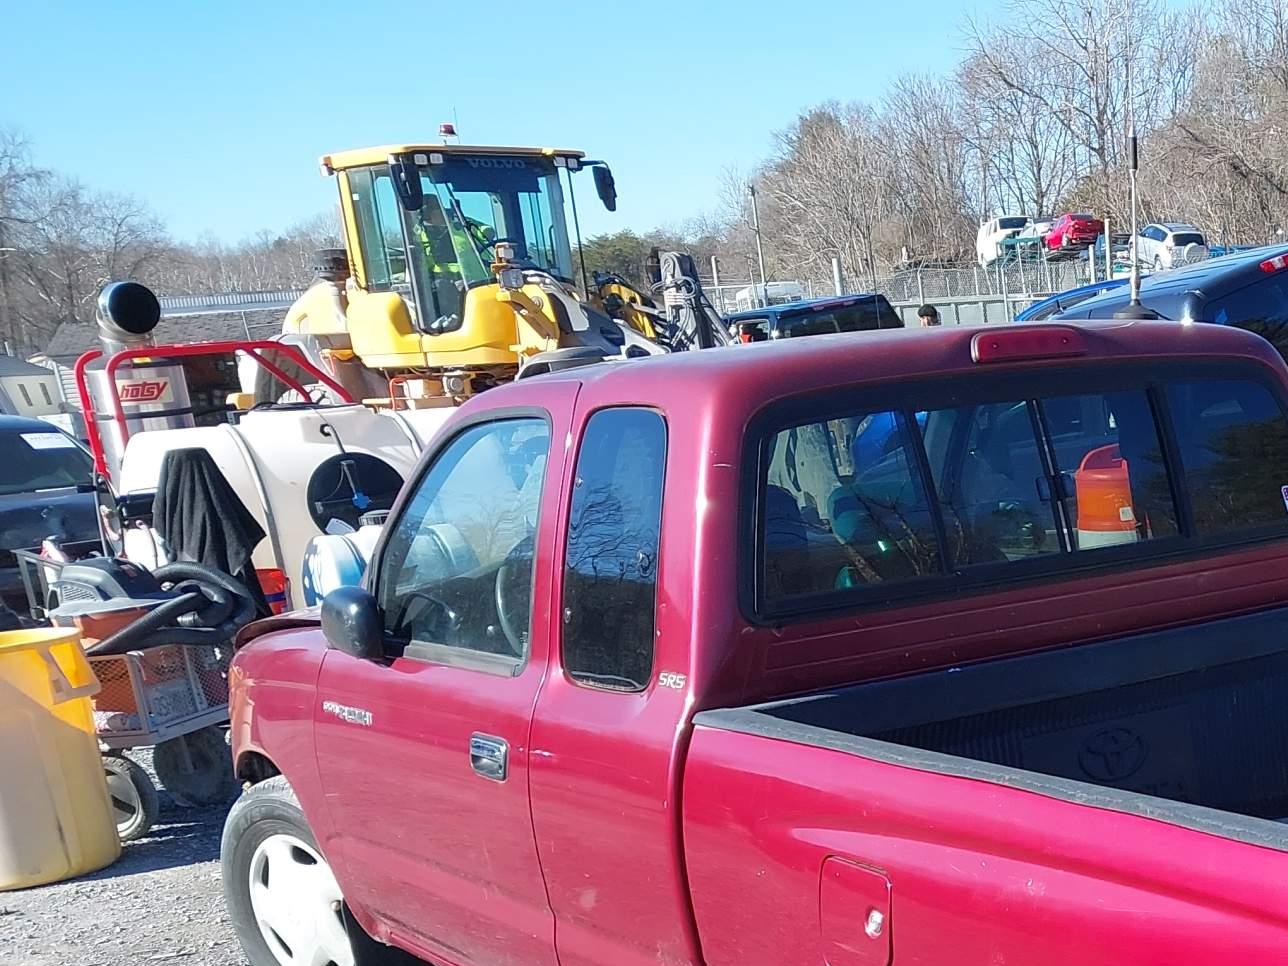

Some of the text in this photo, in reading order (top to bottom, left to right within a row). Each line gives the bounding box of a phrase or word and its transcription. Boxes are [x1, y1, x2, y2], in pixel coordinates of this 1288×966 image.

[466, 158, 527, 169] VOLVO
[120, 381, 168, 401] hotsy
[658, 671, 687, 689] SR5
